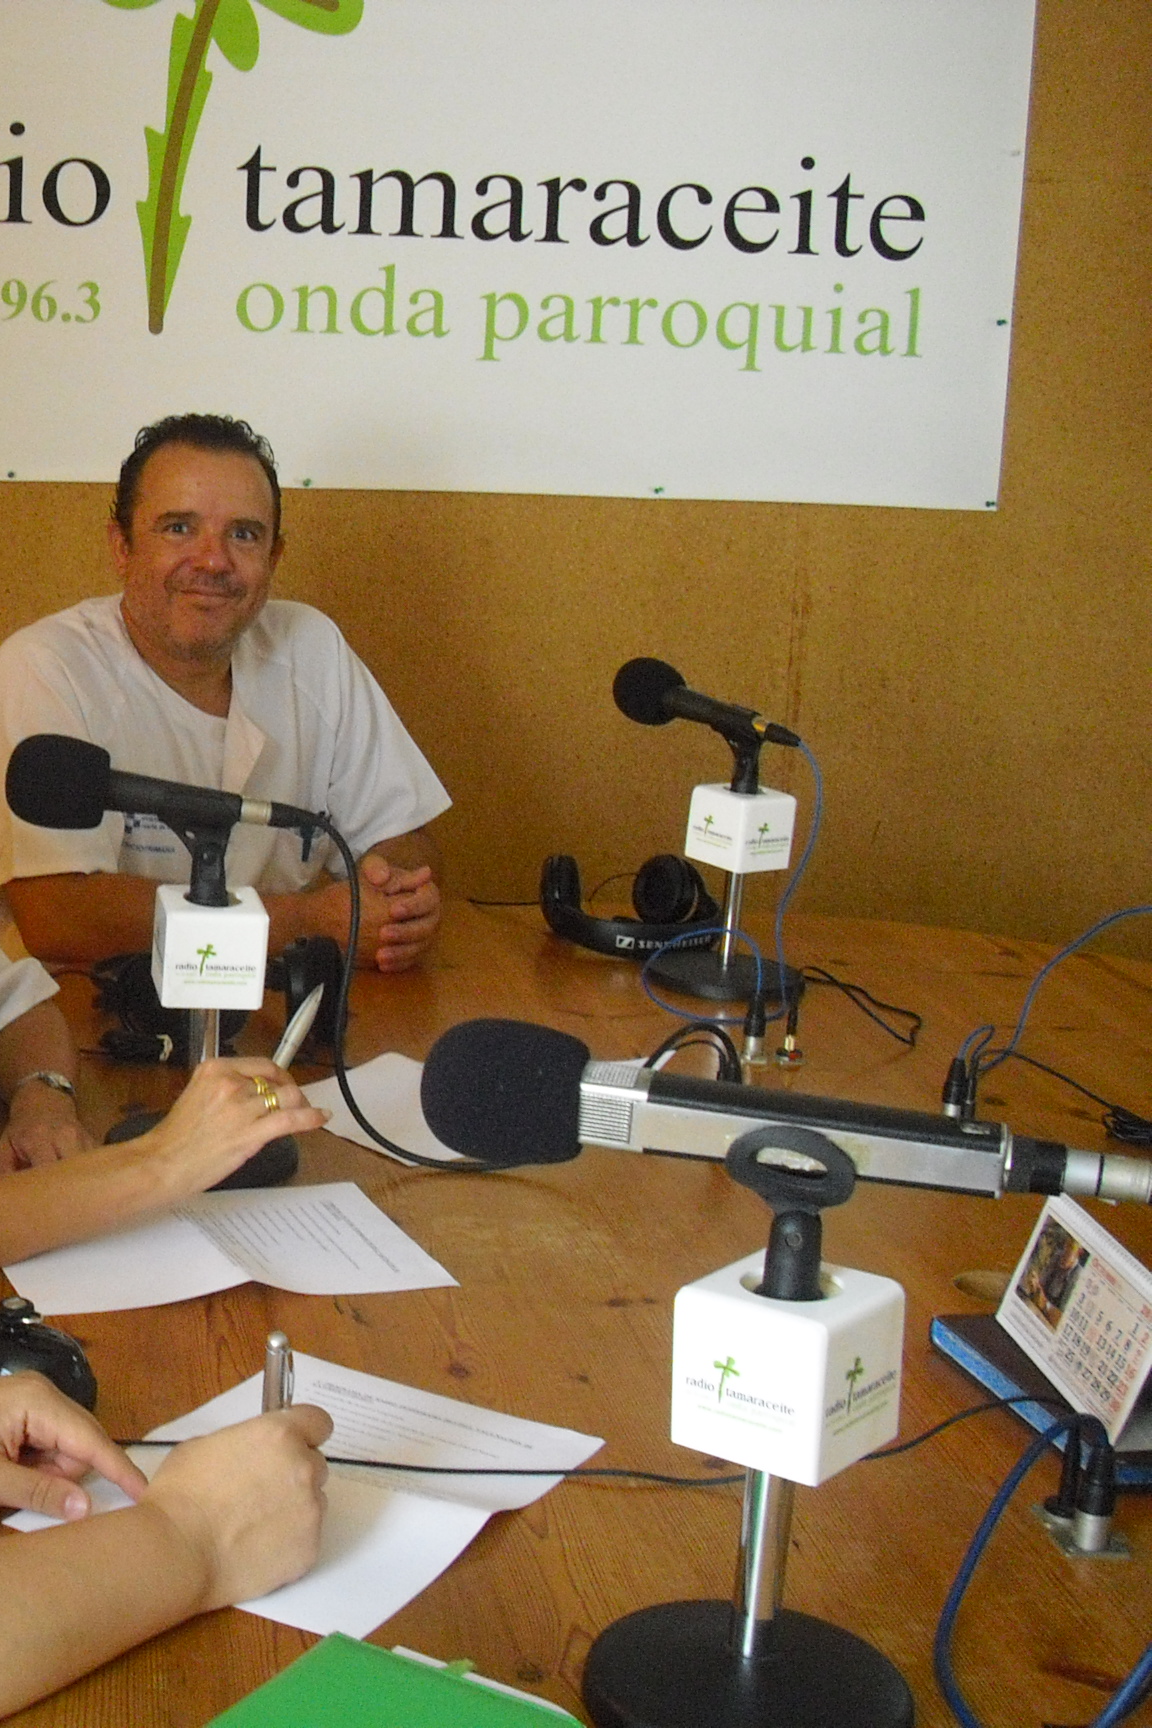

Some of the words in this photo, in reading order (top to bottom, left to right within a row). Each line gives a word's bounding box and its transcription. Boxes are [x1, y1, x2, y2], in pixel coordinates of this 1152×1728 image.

[235, 144, 927, 262] tamaraceite
[235, 263, 451, 338] onda
[476, 282, 924, 372] parroquial
[686, 1375, 715, 1392] radio
[725, 1387, 796, 1416] tamaraceite
[825, 1399, 846, 1418] radio
